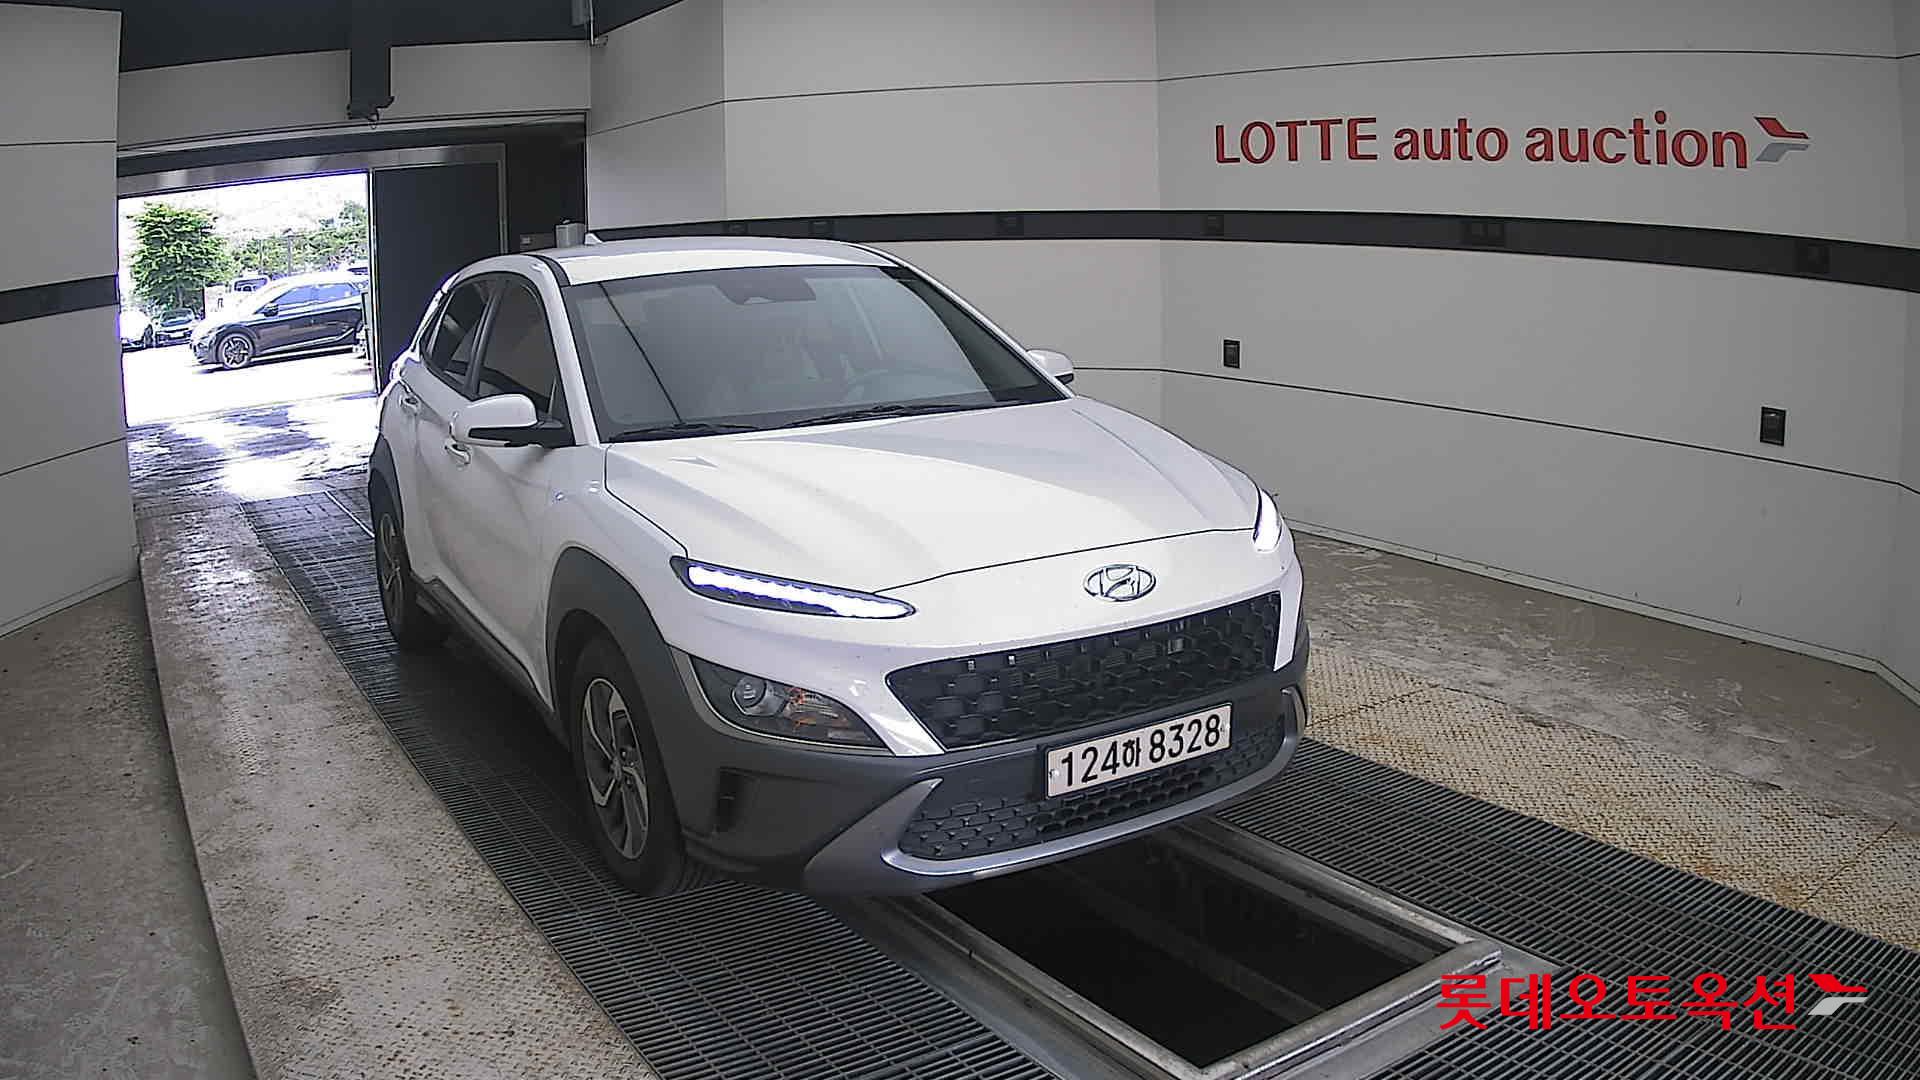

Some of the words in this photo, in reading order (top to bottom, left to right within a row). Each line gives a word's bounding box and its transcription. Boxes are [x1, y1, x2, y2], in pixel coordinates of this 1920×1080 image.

[1215, 117, 1378, 164] LOTTE
[1393, 118, 1509, 161] auto
[1525, 110, 1748, 169] auction
[1061, 737, 1141, 787] 124하
[1149, 714, 1221, 763] 8328
